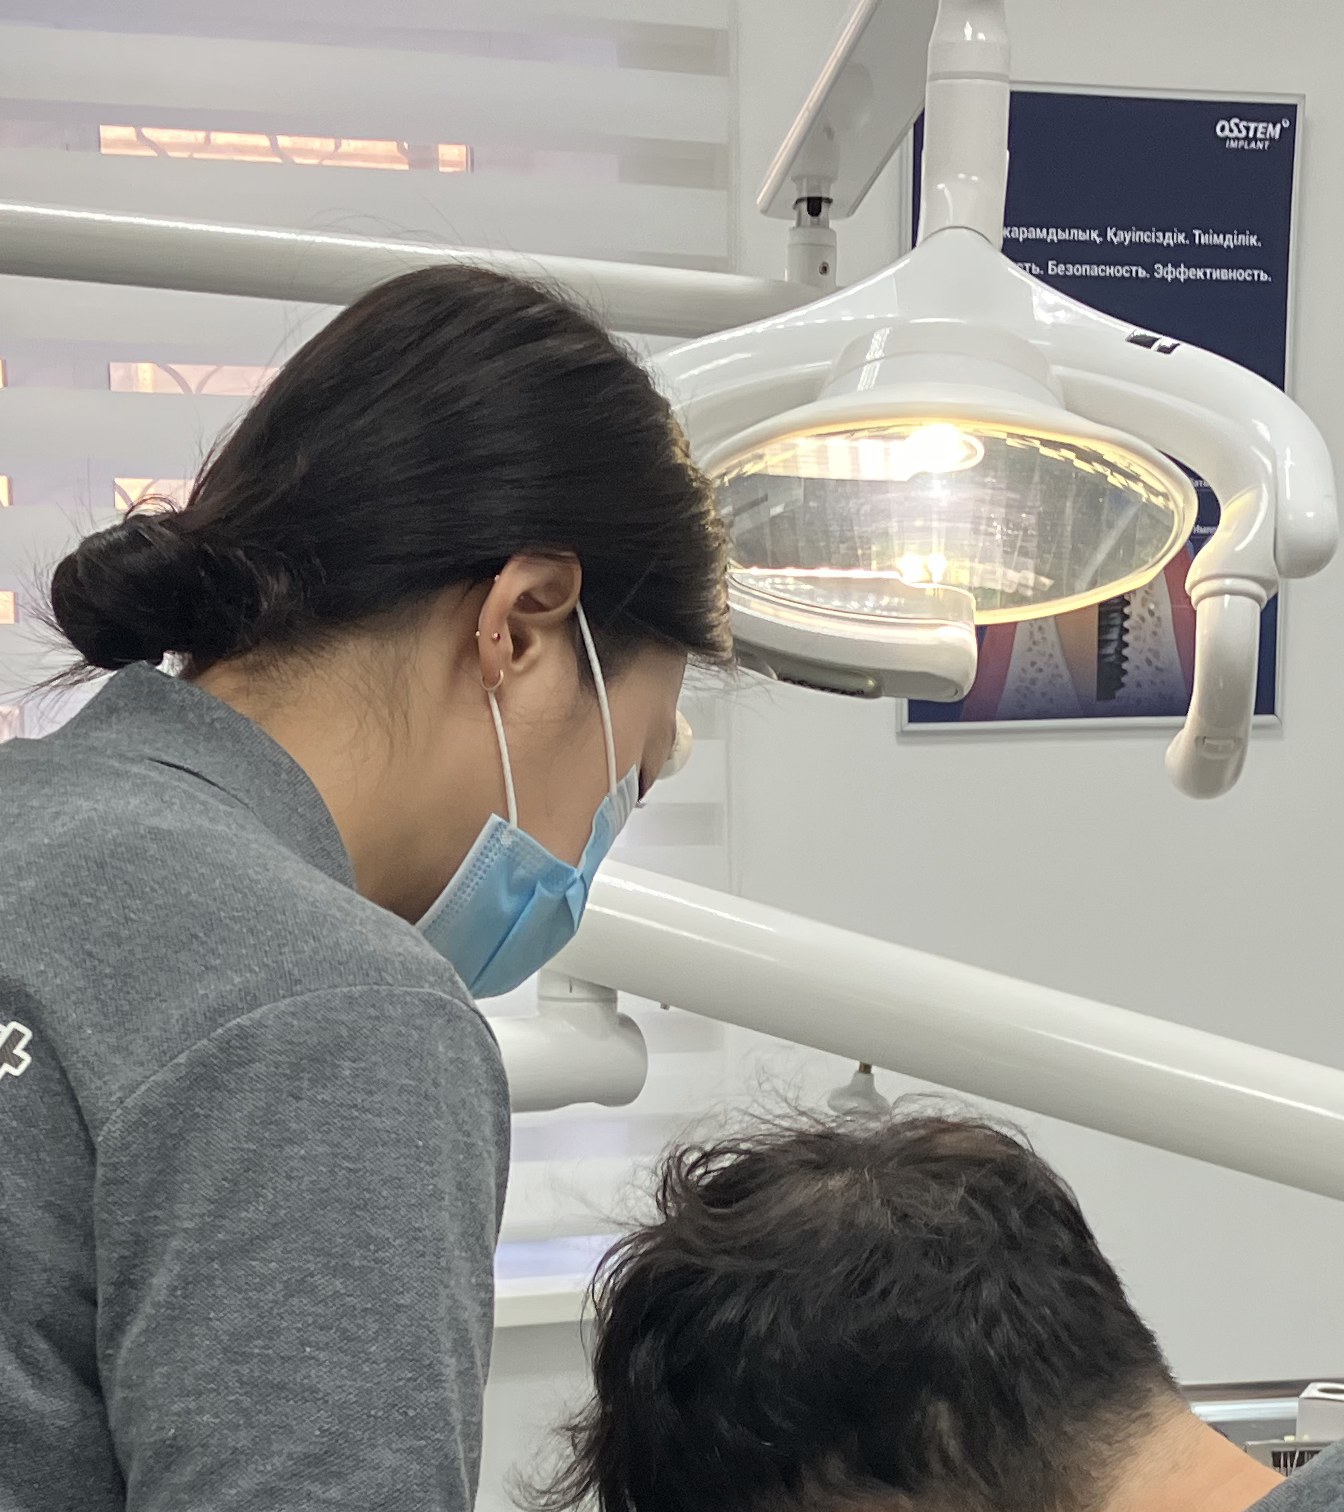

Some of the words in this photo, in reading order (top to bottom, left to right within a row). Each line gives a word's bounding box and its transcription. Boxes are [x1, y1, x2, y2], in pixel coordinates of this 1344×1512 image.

[1225, 138, 1270, 151] IMPLANT
[1003, 226, 1103, 244] карамдылық.
[1106, 226, 1190, 246] Қауіпсіздік.
[1193, 229, 1262, 248] Тиімділік.
[1048, 260, 1151, 279] Безопасность.
[1154, 262, 1273, 283] Эффективность.
